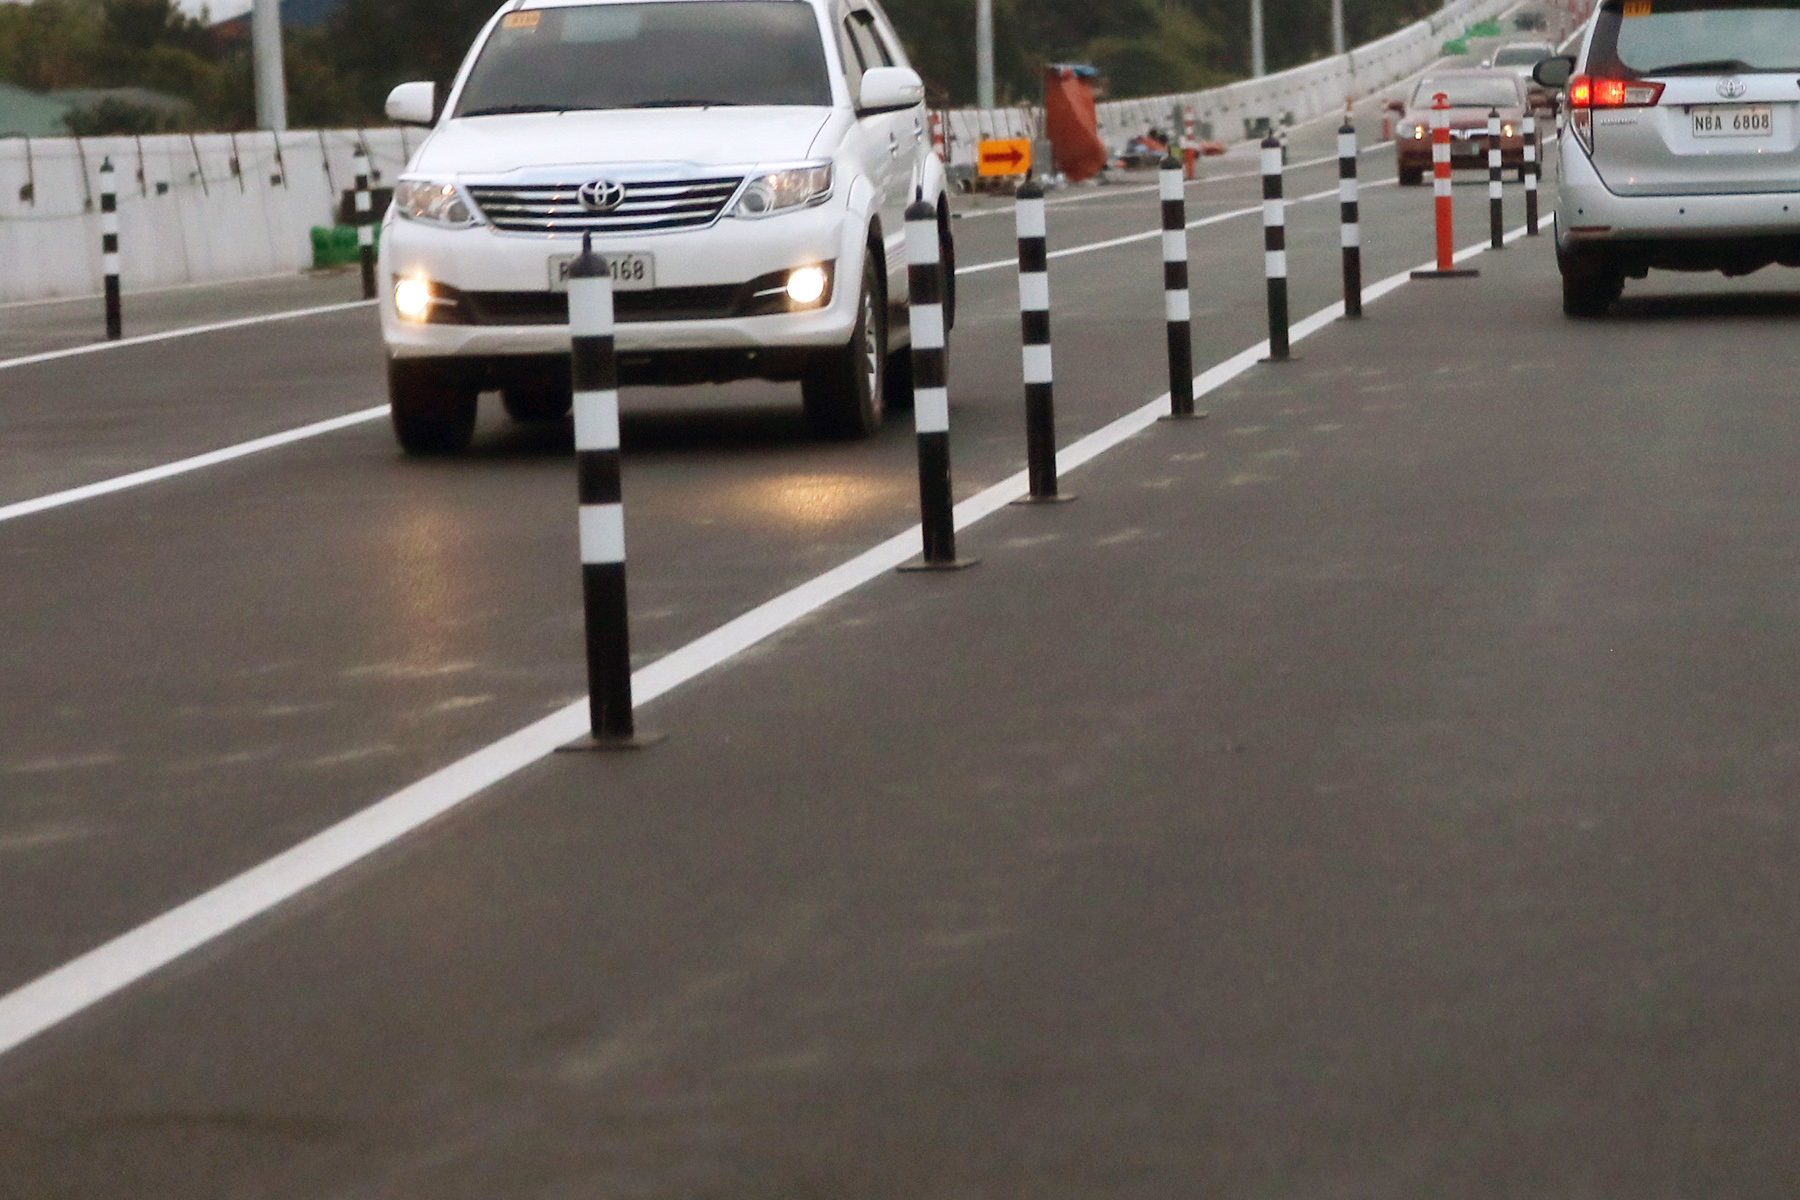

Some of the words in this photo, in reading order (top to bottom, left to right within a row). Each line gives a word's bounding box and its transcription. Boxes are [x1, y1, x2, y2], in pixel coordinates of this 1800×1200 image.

[1695, 115, 1722, 131] NBA
[1733, 114, 1769, 130] 6808
[610, 260, 644, 280] 168
